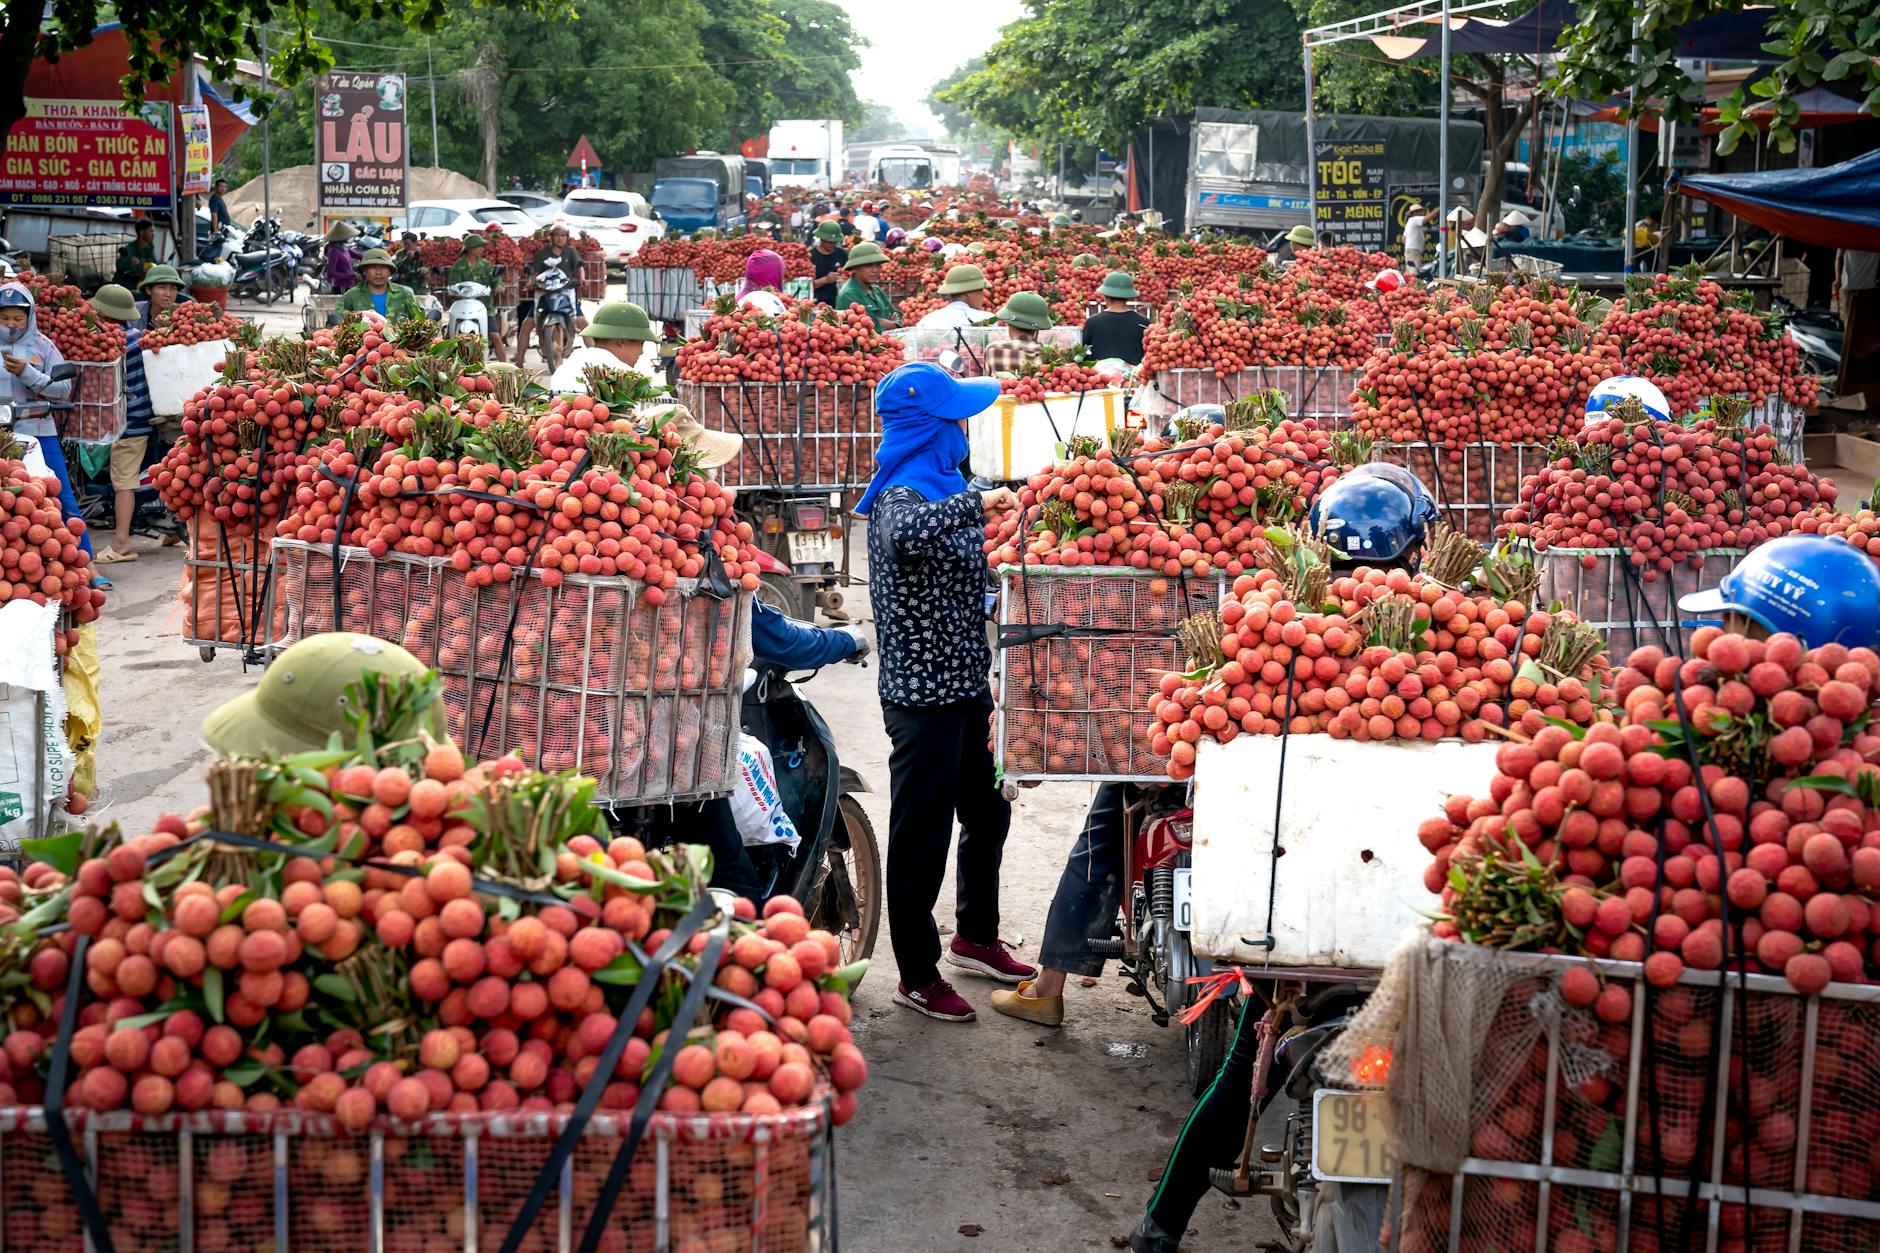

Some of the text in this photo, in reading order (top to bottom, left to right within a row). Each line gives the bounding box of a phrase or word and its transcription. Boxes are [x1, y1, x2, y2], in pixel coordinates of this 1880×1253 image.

[36, 120, 54, 129] BÁN
[56, 120, 82, 129] BUÔN
[90, 120, 110, 129] BÁN
[324, 105, 401, 163] LẨU
[6, 132, 39, 152] HÂN
[45, 132, 78, 153] BÓN
[96, 134, 139, 155] THỨC
[144, 135, 165, 155] ĂN
[7, 157, 33, 175] GIA
[39, 155, 71, 176] SÚC
[88, 159, 115, 177] GIA
[355, 166, 403, 181] CÁC LOẠI
[1318, 156, 1362, 185] TÓC
[325, 183, 400, 197] NHẬN CƠM ĐẶT
[1317, 207, 1331, 219] MI
[47, 742, 63, 765] SUPE
[51, 768, 63, 781] CP
[5, 808, 20, 817] kg
